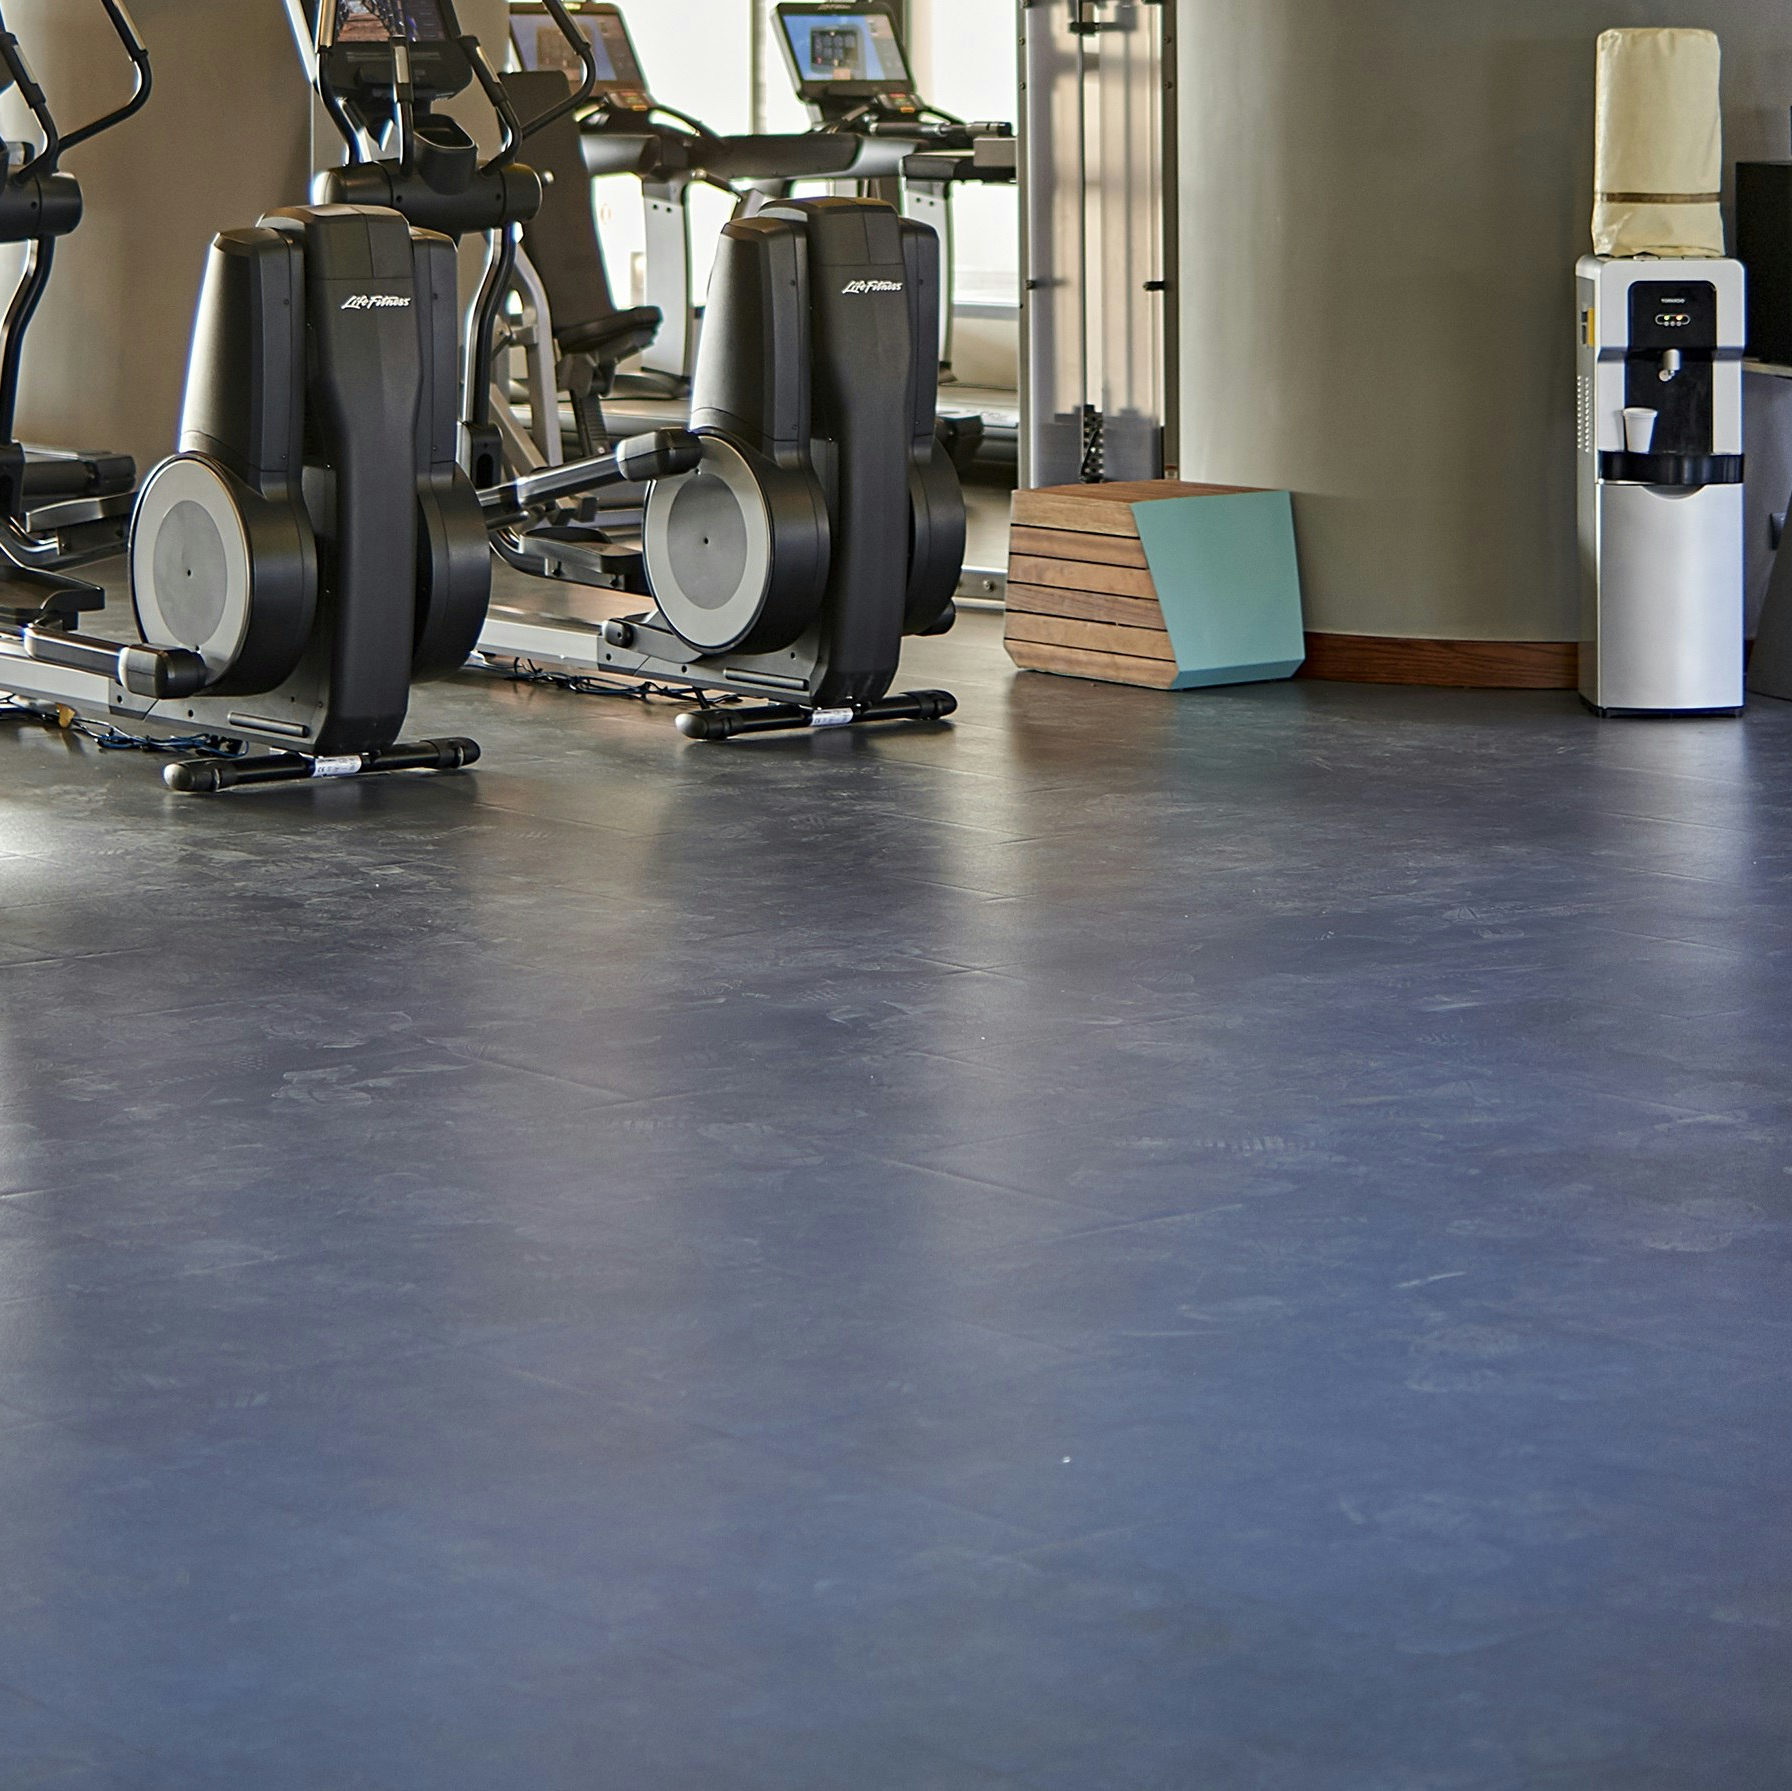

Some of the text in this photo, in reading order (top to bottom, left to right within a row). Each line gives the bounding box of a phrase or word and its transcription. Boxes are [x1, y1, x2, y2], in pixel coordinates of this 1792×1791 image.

[841, 280, 903, 294] Life Fitness
[341, 295, 411, 309] Life Fitness
